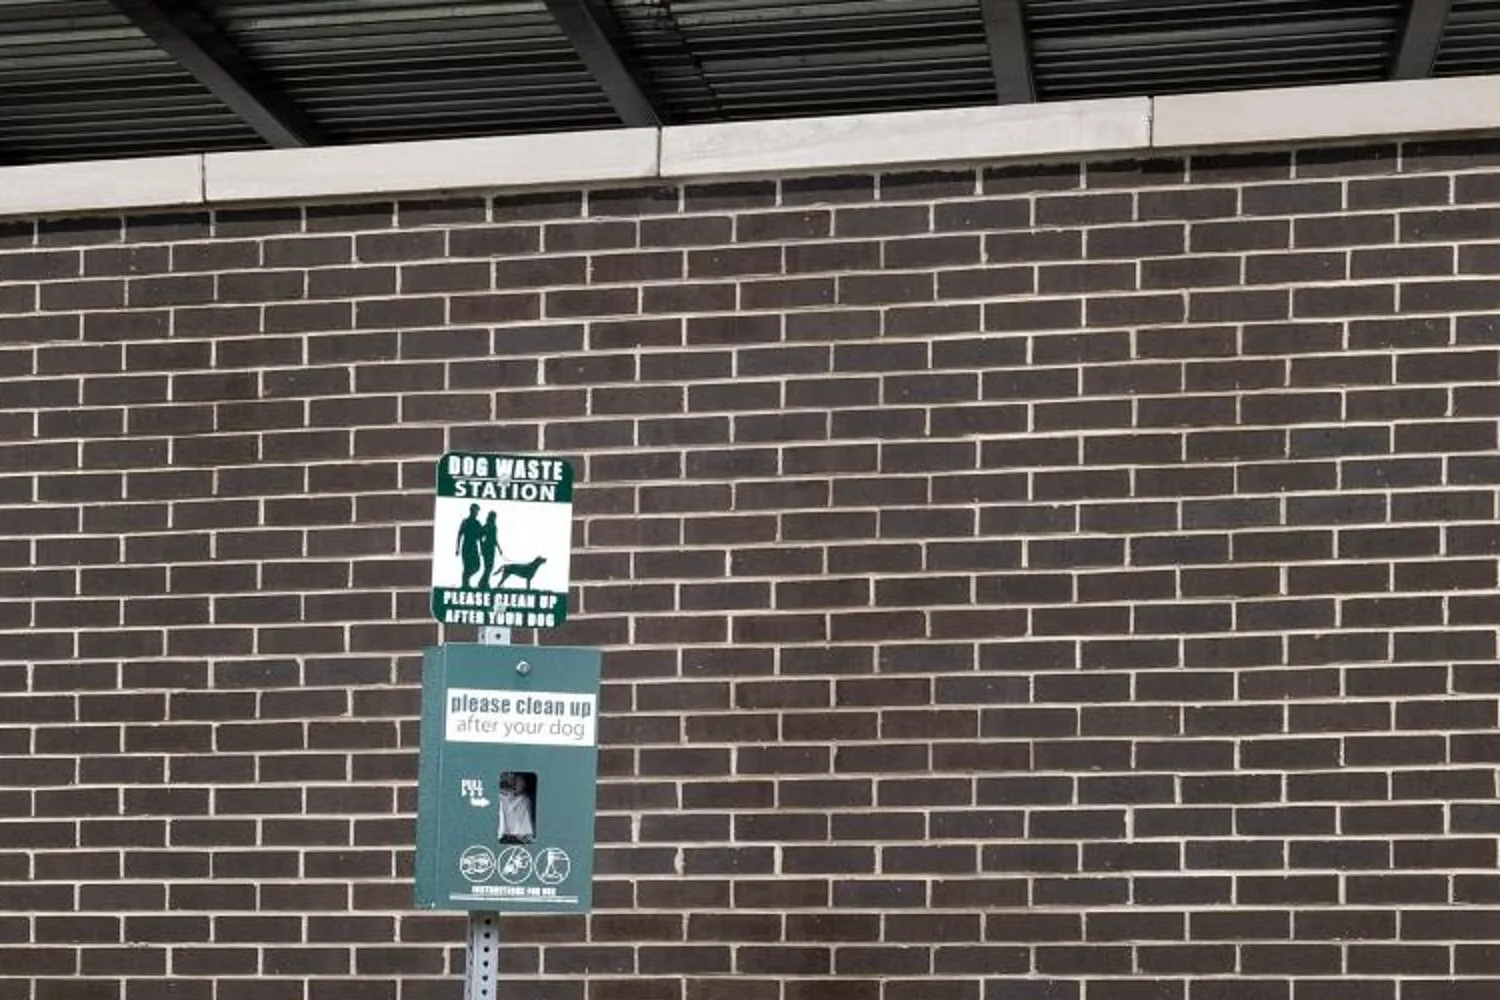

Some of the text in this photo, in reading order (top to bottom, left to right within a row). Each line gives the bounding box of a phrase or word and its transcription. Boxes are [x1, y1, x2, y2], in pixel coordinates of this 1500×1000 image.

[448, 456, 563, 481] DOG WASTE
[454, 480, 555, 501] STATION
[443, 591, 557, 609] PLEASE CLEAN UP
[445, 609, 555, 627] AFTER YOUR DOG
[451, 694, 591, 718] please clean up
[456, 714, 585, 740] after your dog
